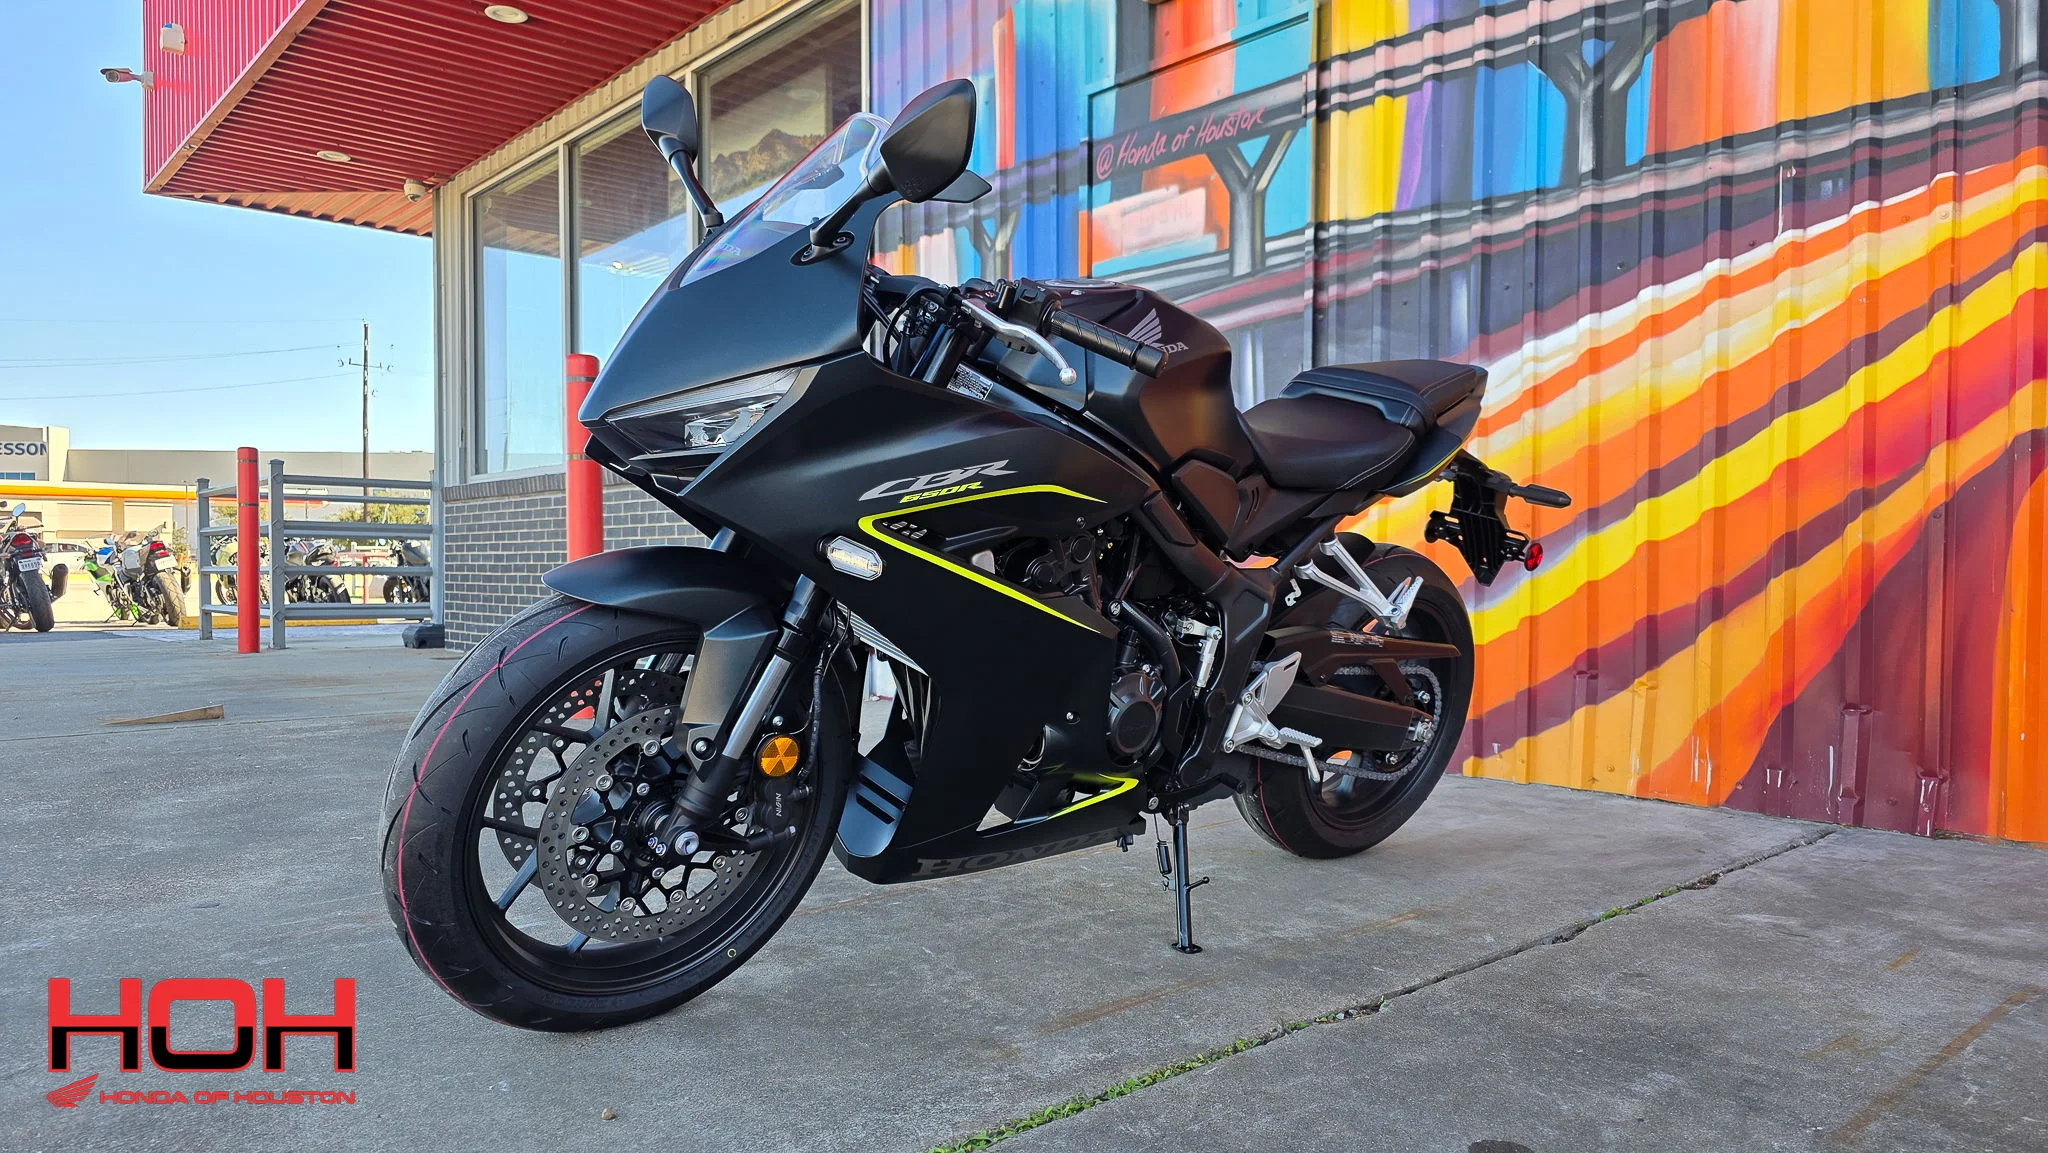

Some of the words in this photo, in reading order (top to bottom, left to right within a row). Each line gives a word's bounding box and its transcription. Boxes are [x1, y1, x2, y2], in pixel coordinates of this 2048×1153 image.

[1117, 130, 1166, 168] Honda
[1171, 125, 1195, 153] of
[1196, 104, 1266, 149] Houston
[0, 442, 48, 456] SSON
[858, 459, 1019, 501] CBR
[899, 481, 984, 504] 650R
